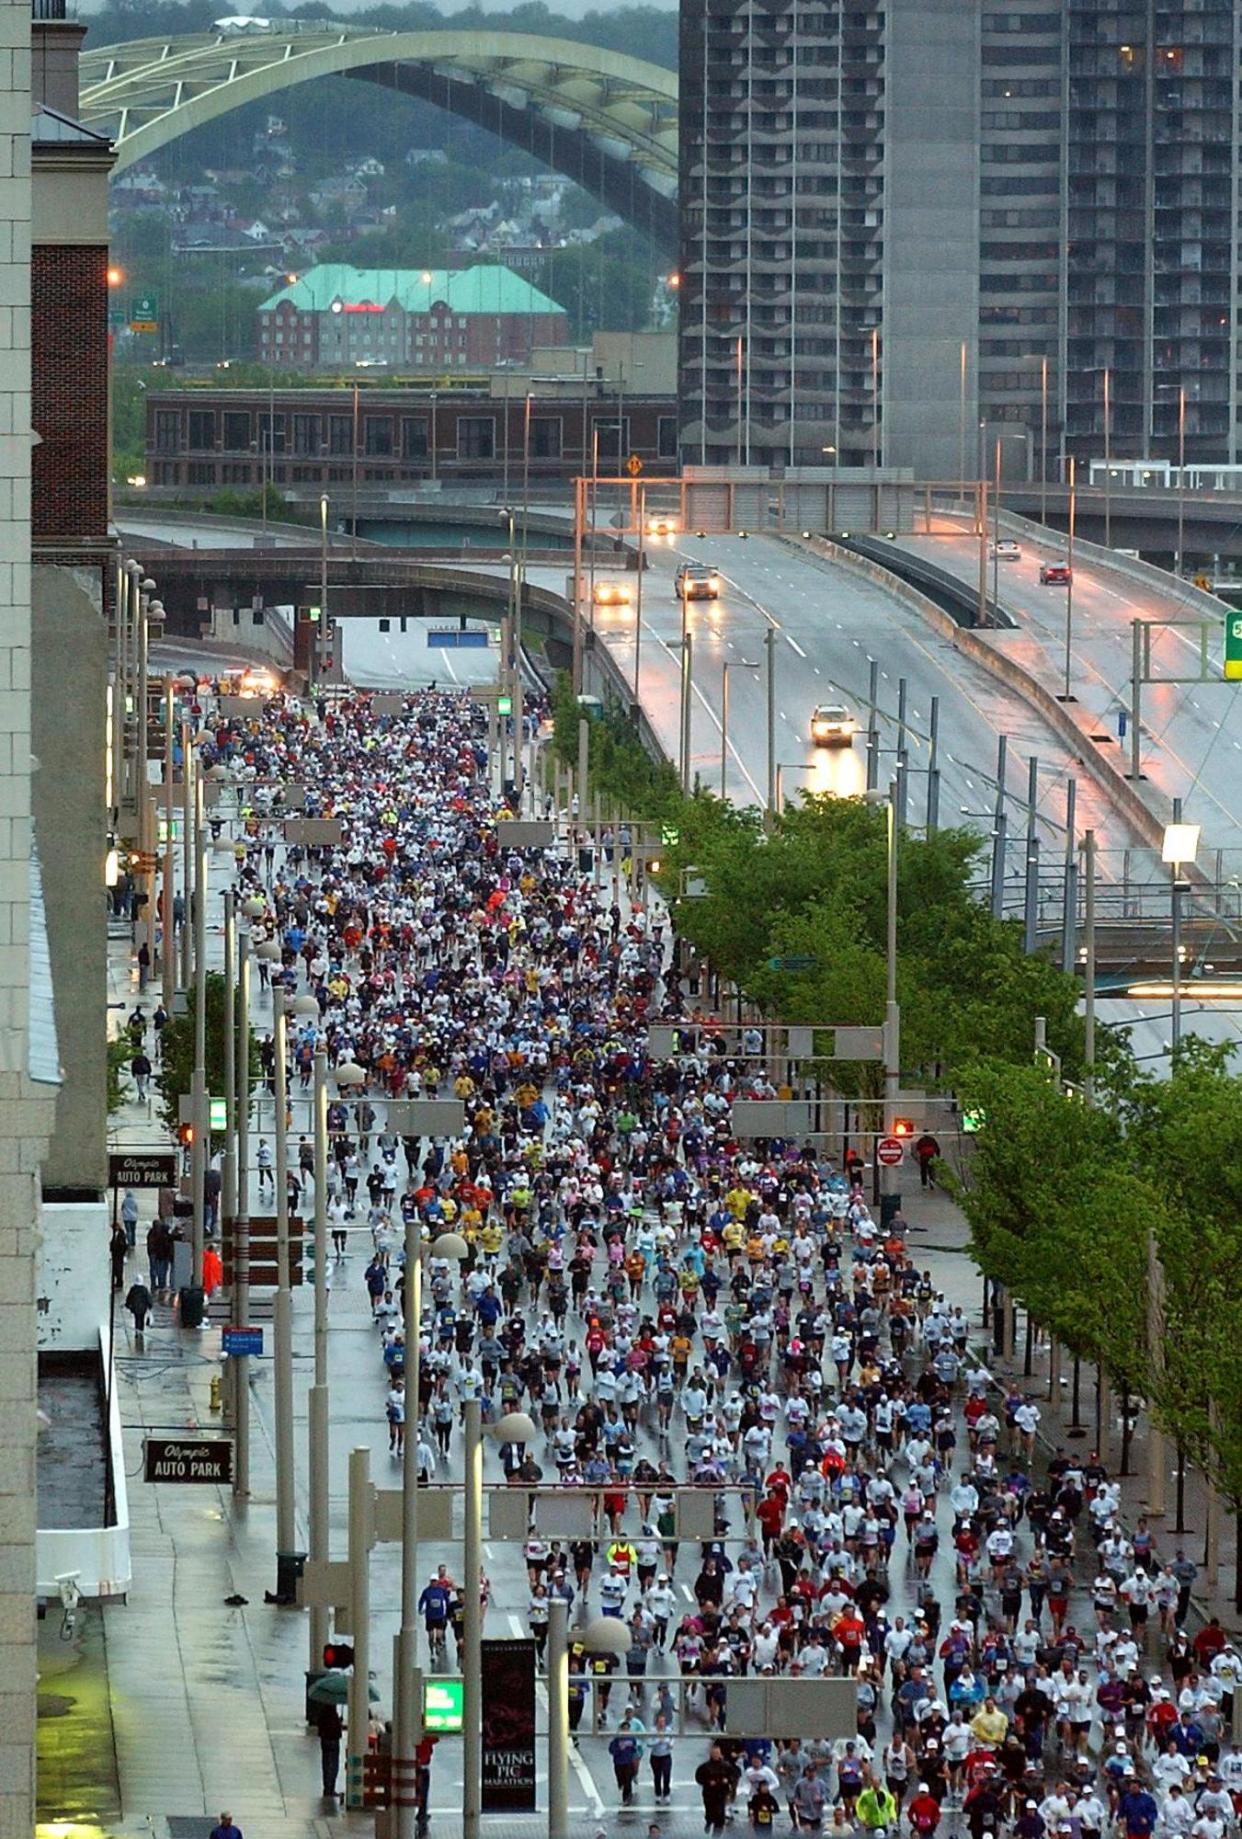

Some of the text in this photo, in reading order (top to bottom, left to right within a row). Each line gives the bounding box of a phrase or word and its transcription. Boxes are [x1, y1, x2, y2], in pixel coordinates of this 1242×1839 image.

[123, 1157, 160, 1170] Olympic
[117, 1171, 169, 1183] AUTO PARK
[164, 1444, 210, 1460] Olympic
[155, 1461, 221, 1477] AUTO PARK
[484, 1751, 534, 1767] FLYING
[497, 1765, 522, 1778] PIG
[484, 1778, 534, 1787] MARATHON
